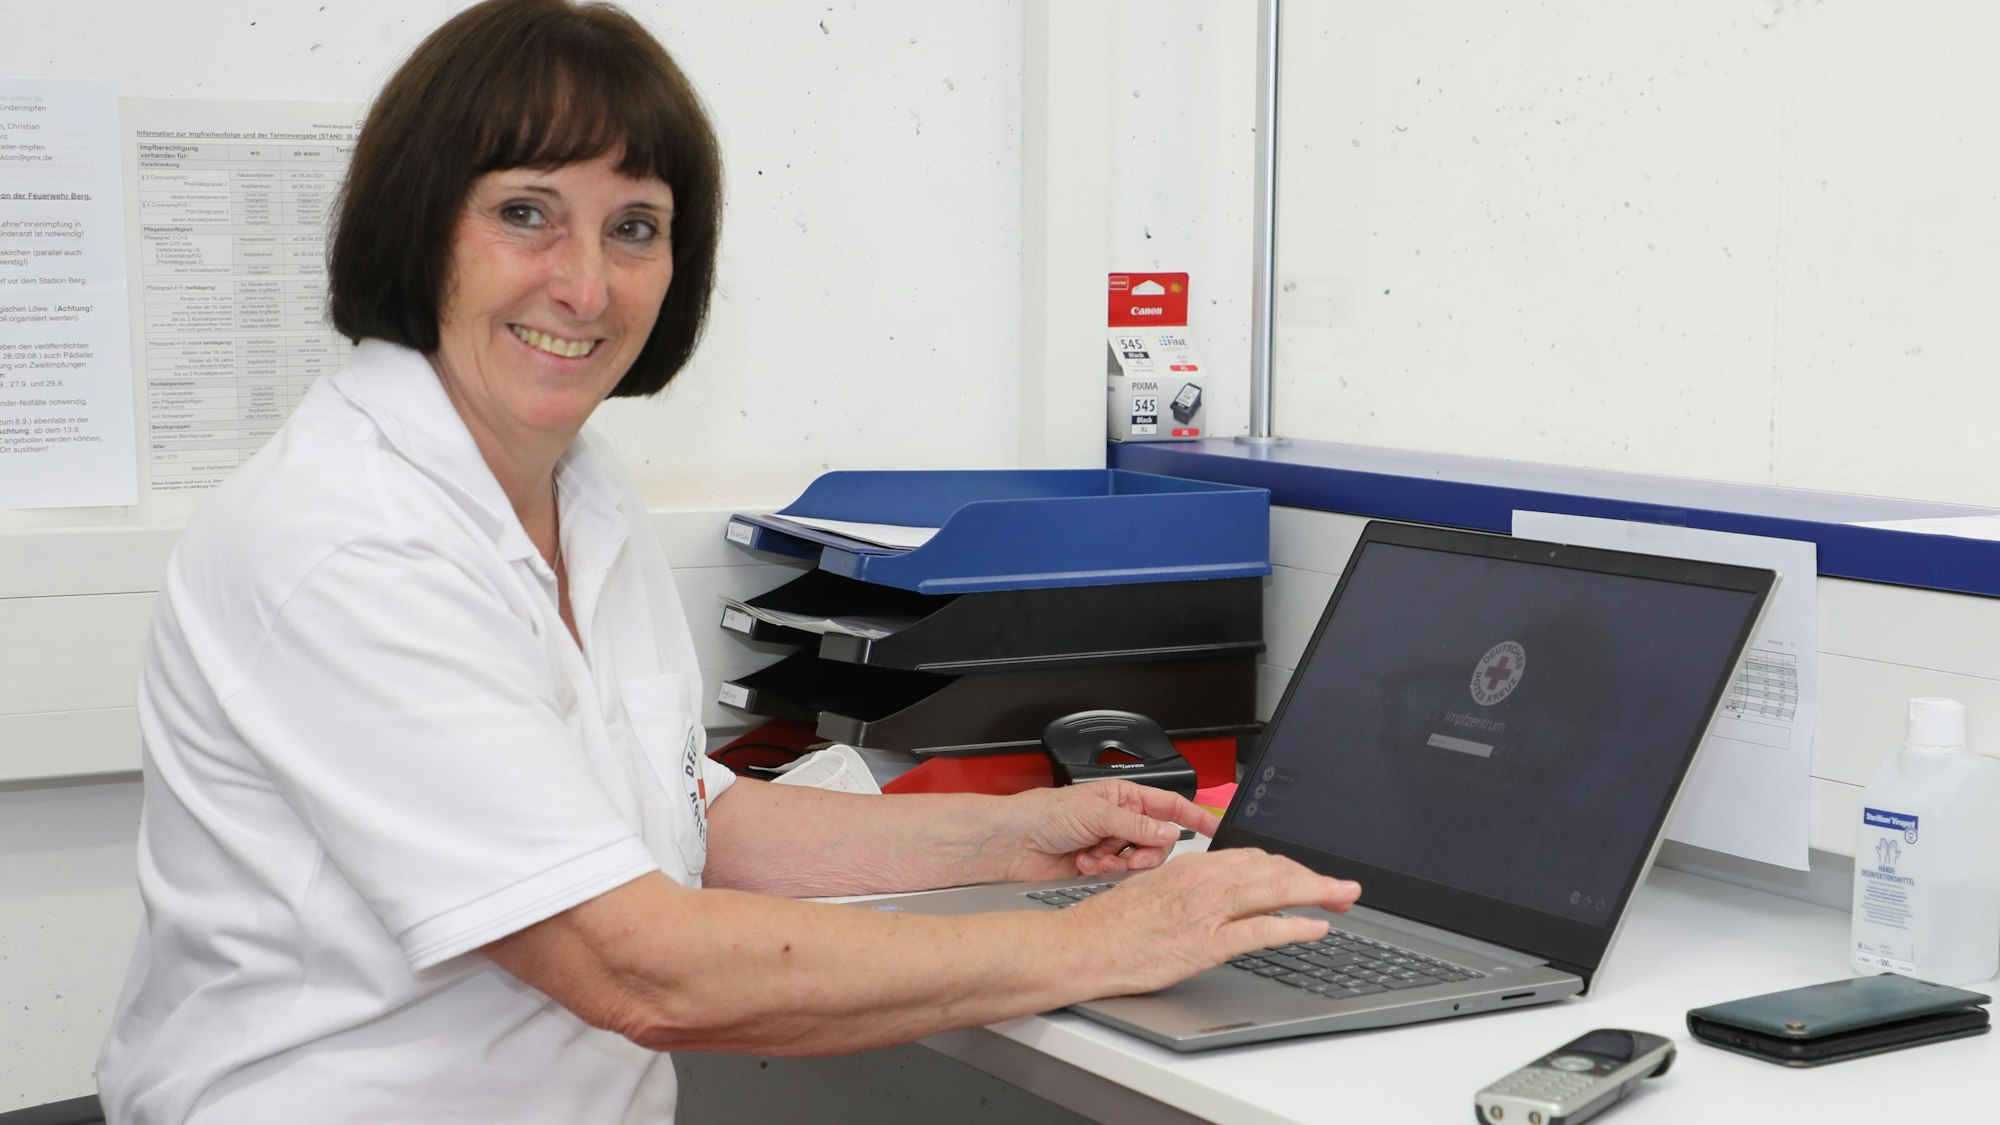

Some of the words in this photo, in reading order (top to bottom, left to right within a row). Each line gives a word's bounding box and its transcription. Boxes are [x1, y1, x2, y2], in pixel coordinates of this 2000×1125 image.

[7, 122, 40, 131] Christian
[137, 130, 175, 138] Information
[188, 131, 241, 139] Impfreihenfolge
[270, 132, 317, 140] Terminvergabe
[0, 154, 53, 162] kcon@gmx.de
[13, 192, 26, 200] der
[28, 192, 69, 200] Feuerwehr
[71, 192, 92, 201] Berg.
[75, 220, 82, 228] in
[0, 230, 32, 238] inderarzt
[45, 230, 84, 239] notwendig!
[33, 248, 62, 257] (parallel
[68, 277, 87, 286] Berg.
[1131, 306, 1162, 315] Canon
[9, 314, 47, 323] organisiert
[49, 314, 79, 322] werden)
[34, 341, 89, 350] veröffentlichten
[1121, 339, 1142, 349] 545
[1168, 338, 1188, 346] FINE
[29, 361, 87, 370] Zweitimpfungen
[1132, 382, 1158, 390] PIXMA
[0, 399, 47, 407] nder-Notfälle
[49, 398, 88, 406] notwendig.
[1135, 399, 1155, 412] 545
[4, 436, 43, 445] angeboten
[1483, 644, 1523, 671] DEUTSCHES
[1473, 671, 1486, 701] ROTES
[1486, 677, 1518, 703] KREUZ
[1444, 710, 1506, 733] Impfzentrum
[1878, 864, 1897, 875] HÄNDE-
[1861, 868, 1916, 886] DESINFEKTIONSMITTEL
